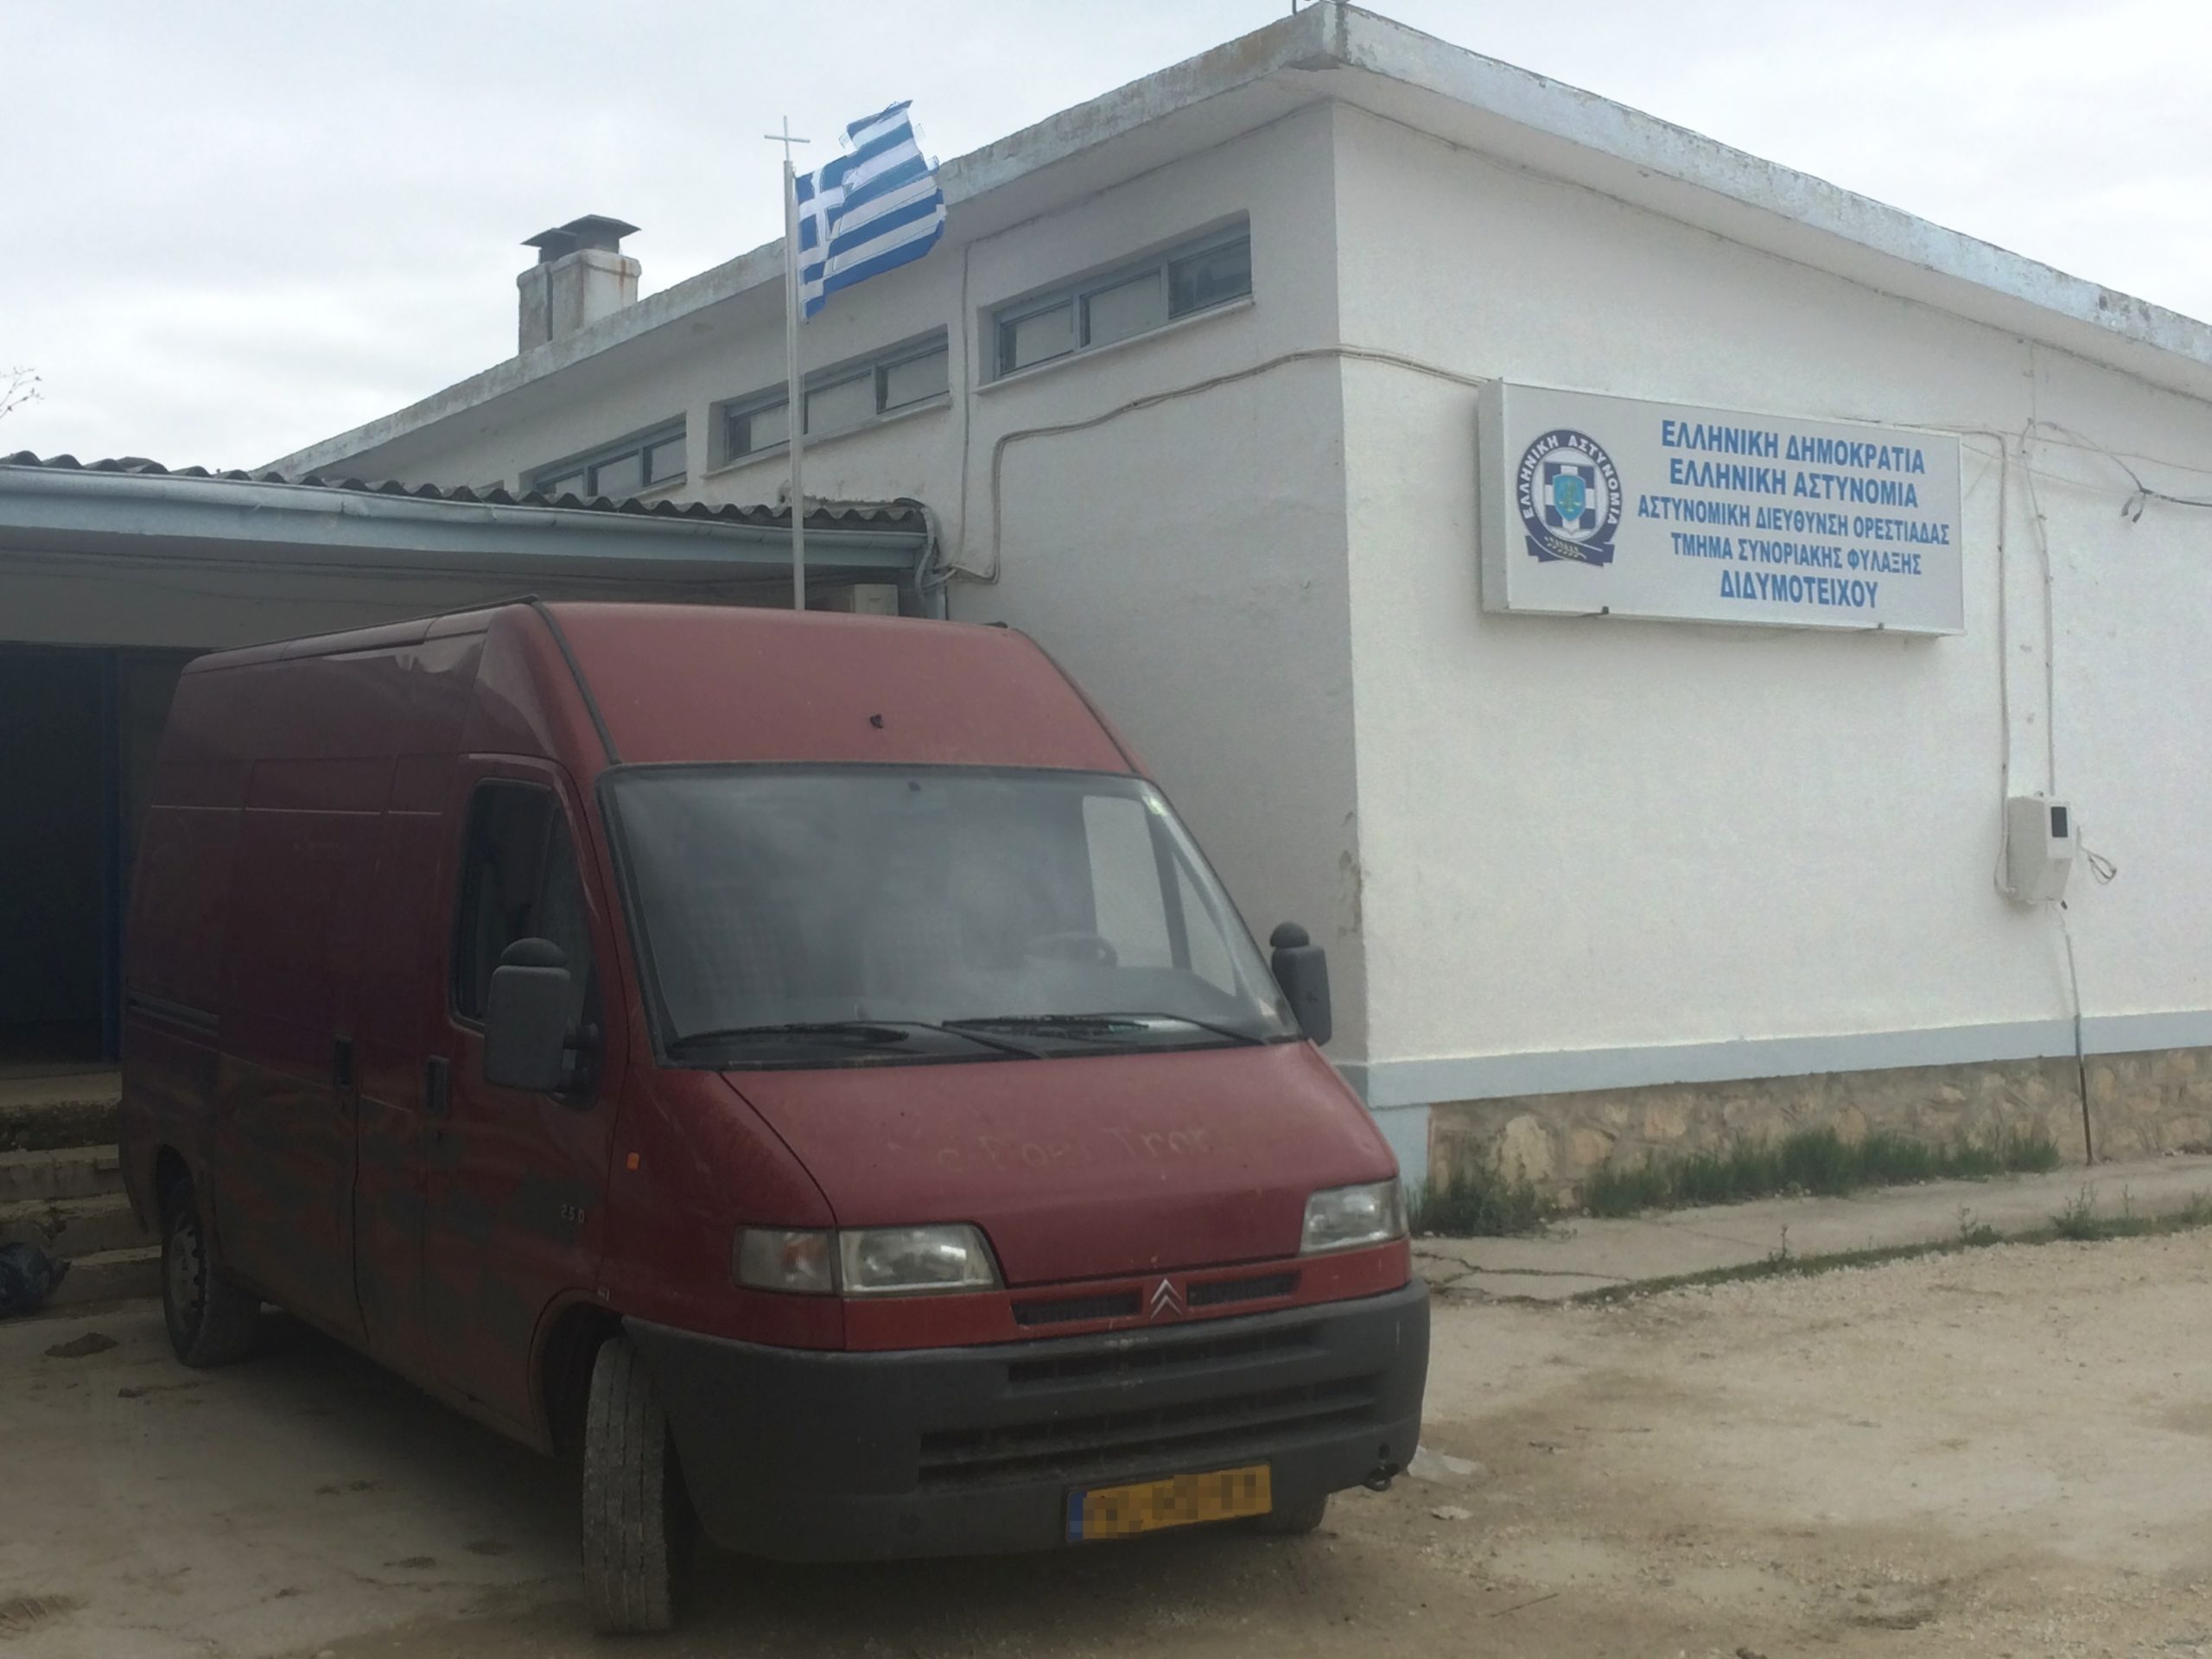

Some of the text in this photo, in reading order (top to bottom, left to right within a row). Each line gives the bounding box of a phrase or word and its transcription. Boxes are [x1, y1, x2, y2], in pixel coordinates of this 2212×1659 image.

[1662, 420, 1925, 474] ΕΛΛΗΝΙΚΗ ΔΗΜΟΚΡΑΤΙΑ
[1519, 435, 1621, 524] ΕΛΛΗΝΙΚΗ ΑΣΤΥΝΟΜΙΑ
[1669, 457, 1918, 508] ΕΛΛΗΝΙΚΗ ΑΣΤΥΝΟΜΙΑ
[1638, 495, 1949, 545] ΑΣΤΥΝΟΜΙΚΗ ΔΙΕΥΘΥΝΣΗ ΟΡΕΣΤΙΑΔΑΣ
[1671, 531, 1922, 575] ΤΜΗΜΑ ΣΥΝΟΡΙΑΚΗΣ ΦΥΛΑΞΗΣ
[1720, 570, 1878, 608] ΔΙΔΥΜΟΤΕΙΧΟΥ
